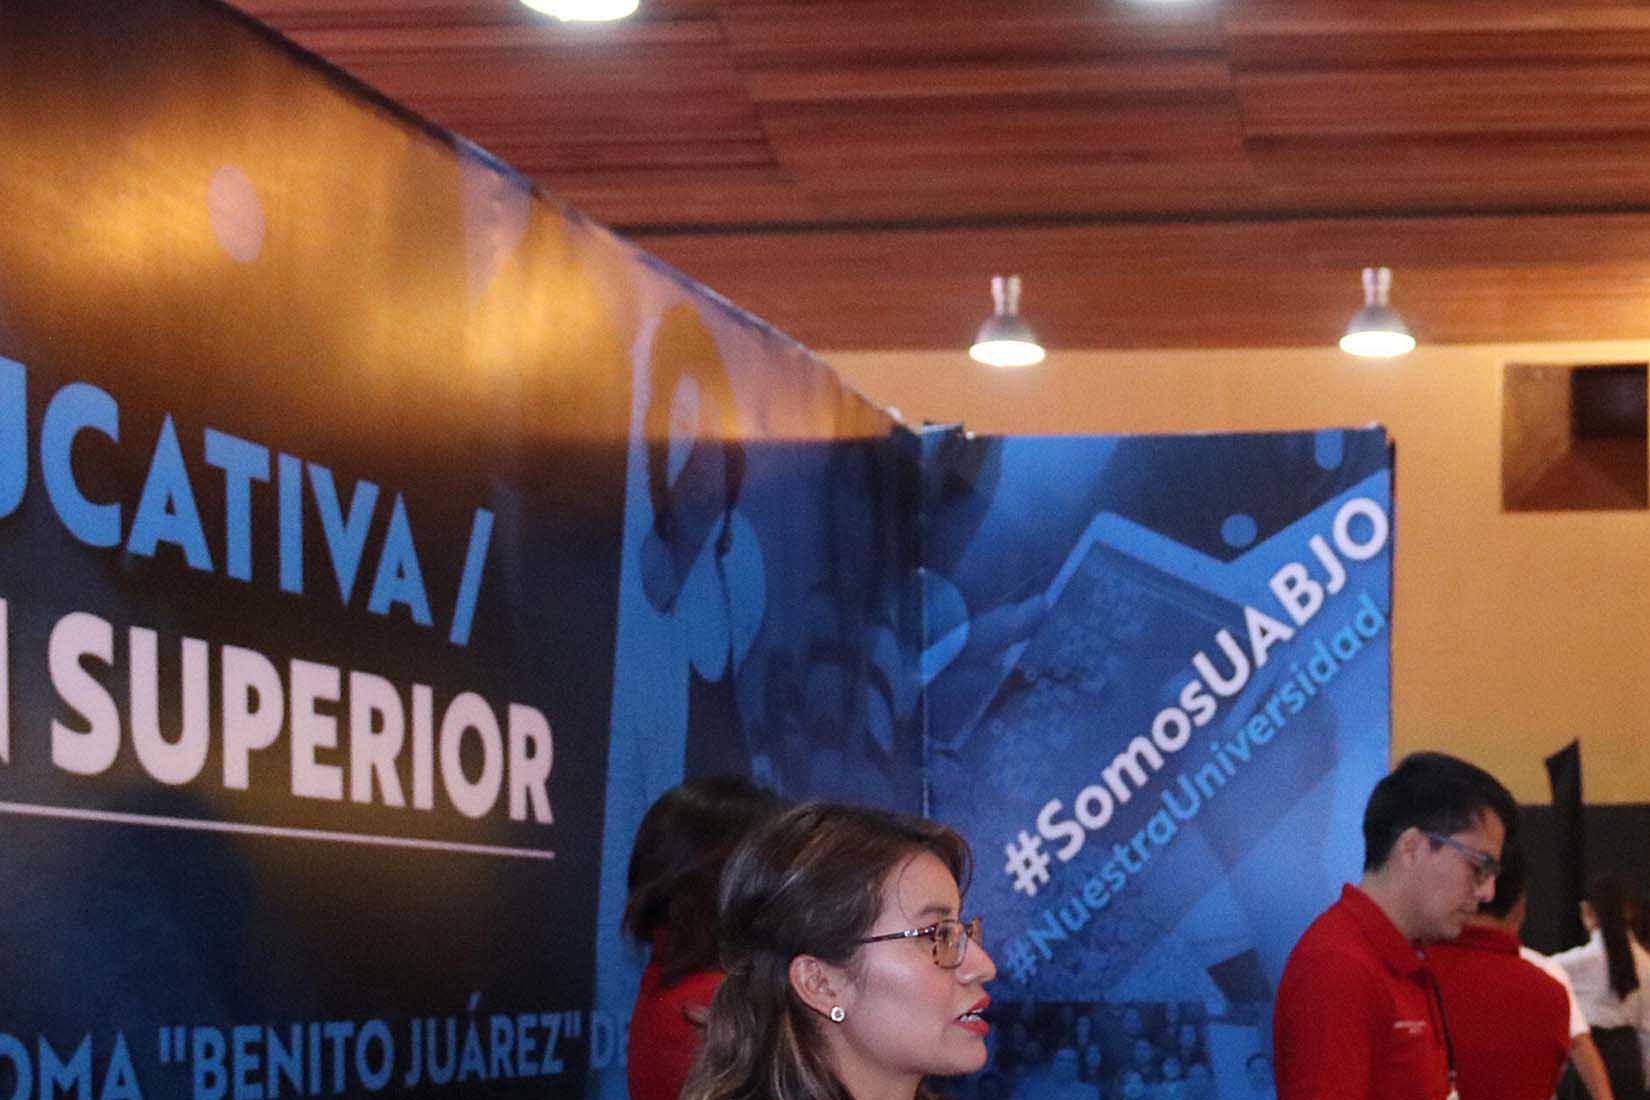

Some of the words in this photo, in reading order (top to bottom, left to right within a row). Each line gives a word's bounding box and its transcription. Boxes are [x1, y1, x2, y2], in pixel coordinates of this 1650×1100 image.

[48, 611, 554, 824] SUPERIOR
[1003, 496, 1390, 896] #SomosUABJO
[1004, 594, 1386, 984] #NuestraUniversidad
[404, 992, 582, 1088] JUÁREZ"
